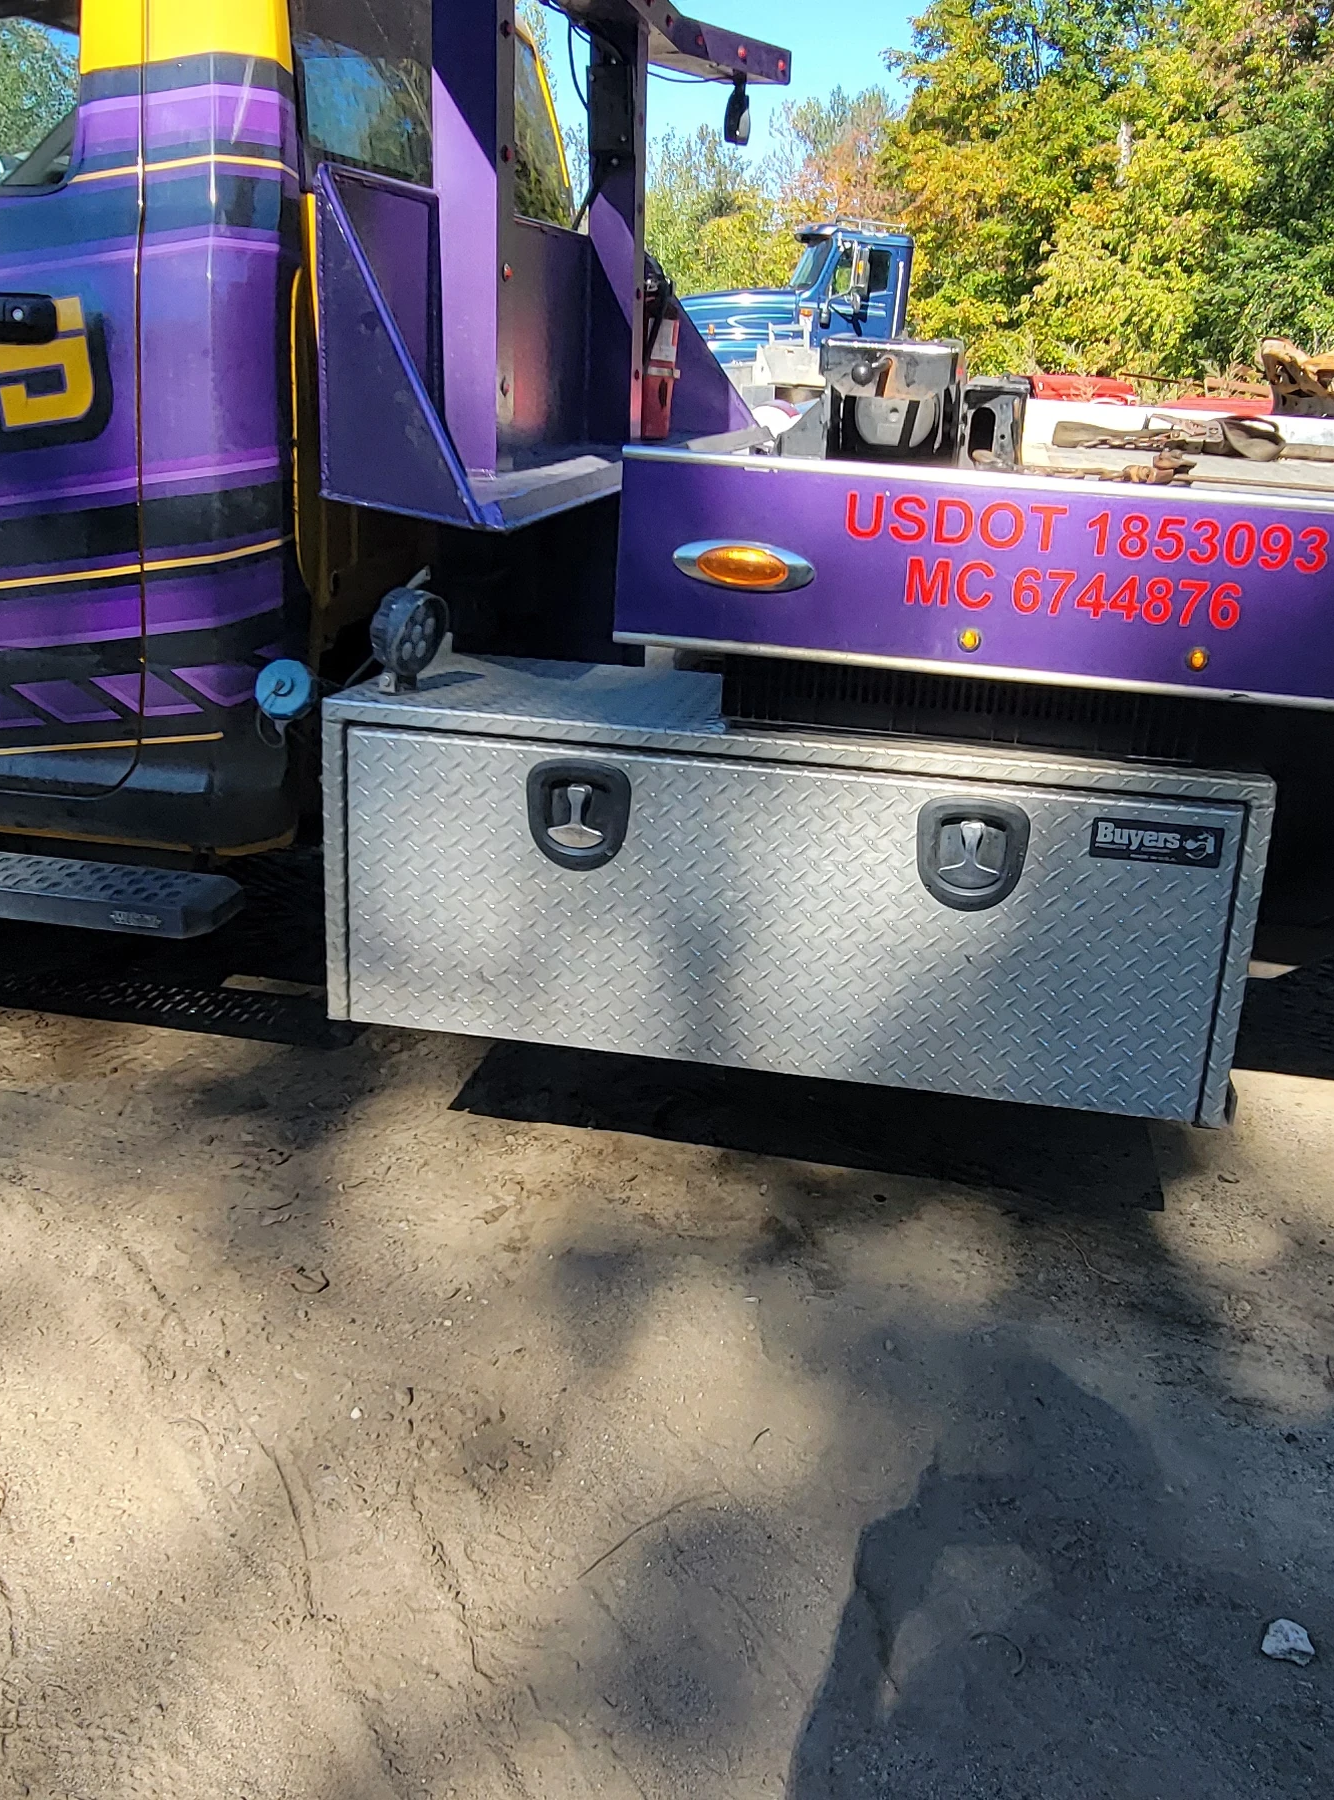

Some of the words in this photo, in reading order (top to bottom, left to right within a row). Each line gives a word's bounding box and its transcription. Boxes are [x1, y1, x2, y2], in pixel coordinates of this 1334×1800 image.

[845, 491, 1069, 554] USDOT
[1085, 510, 1330, 575] 1853093
[903, 556, 996, 610] MC
[1011, 568, 1243, 631] 6744876
[1096, 820, 1181, 850] Buyers
